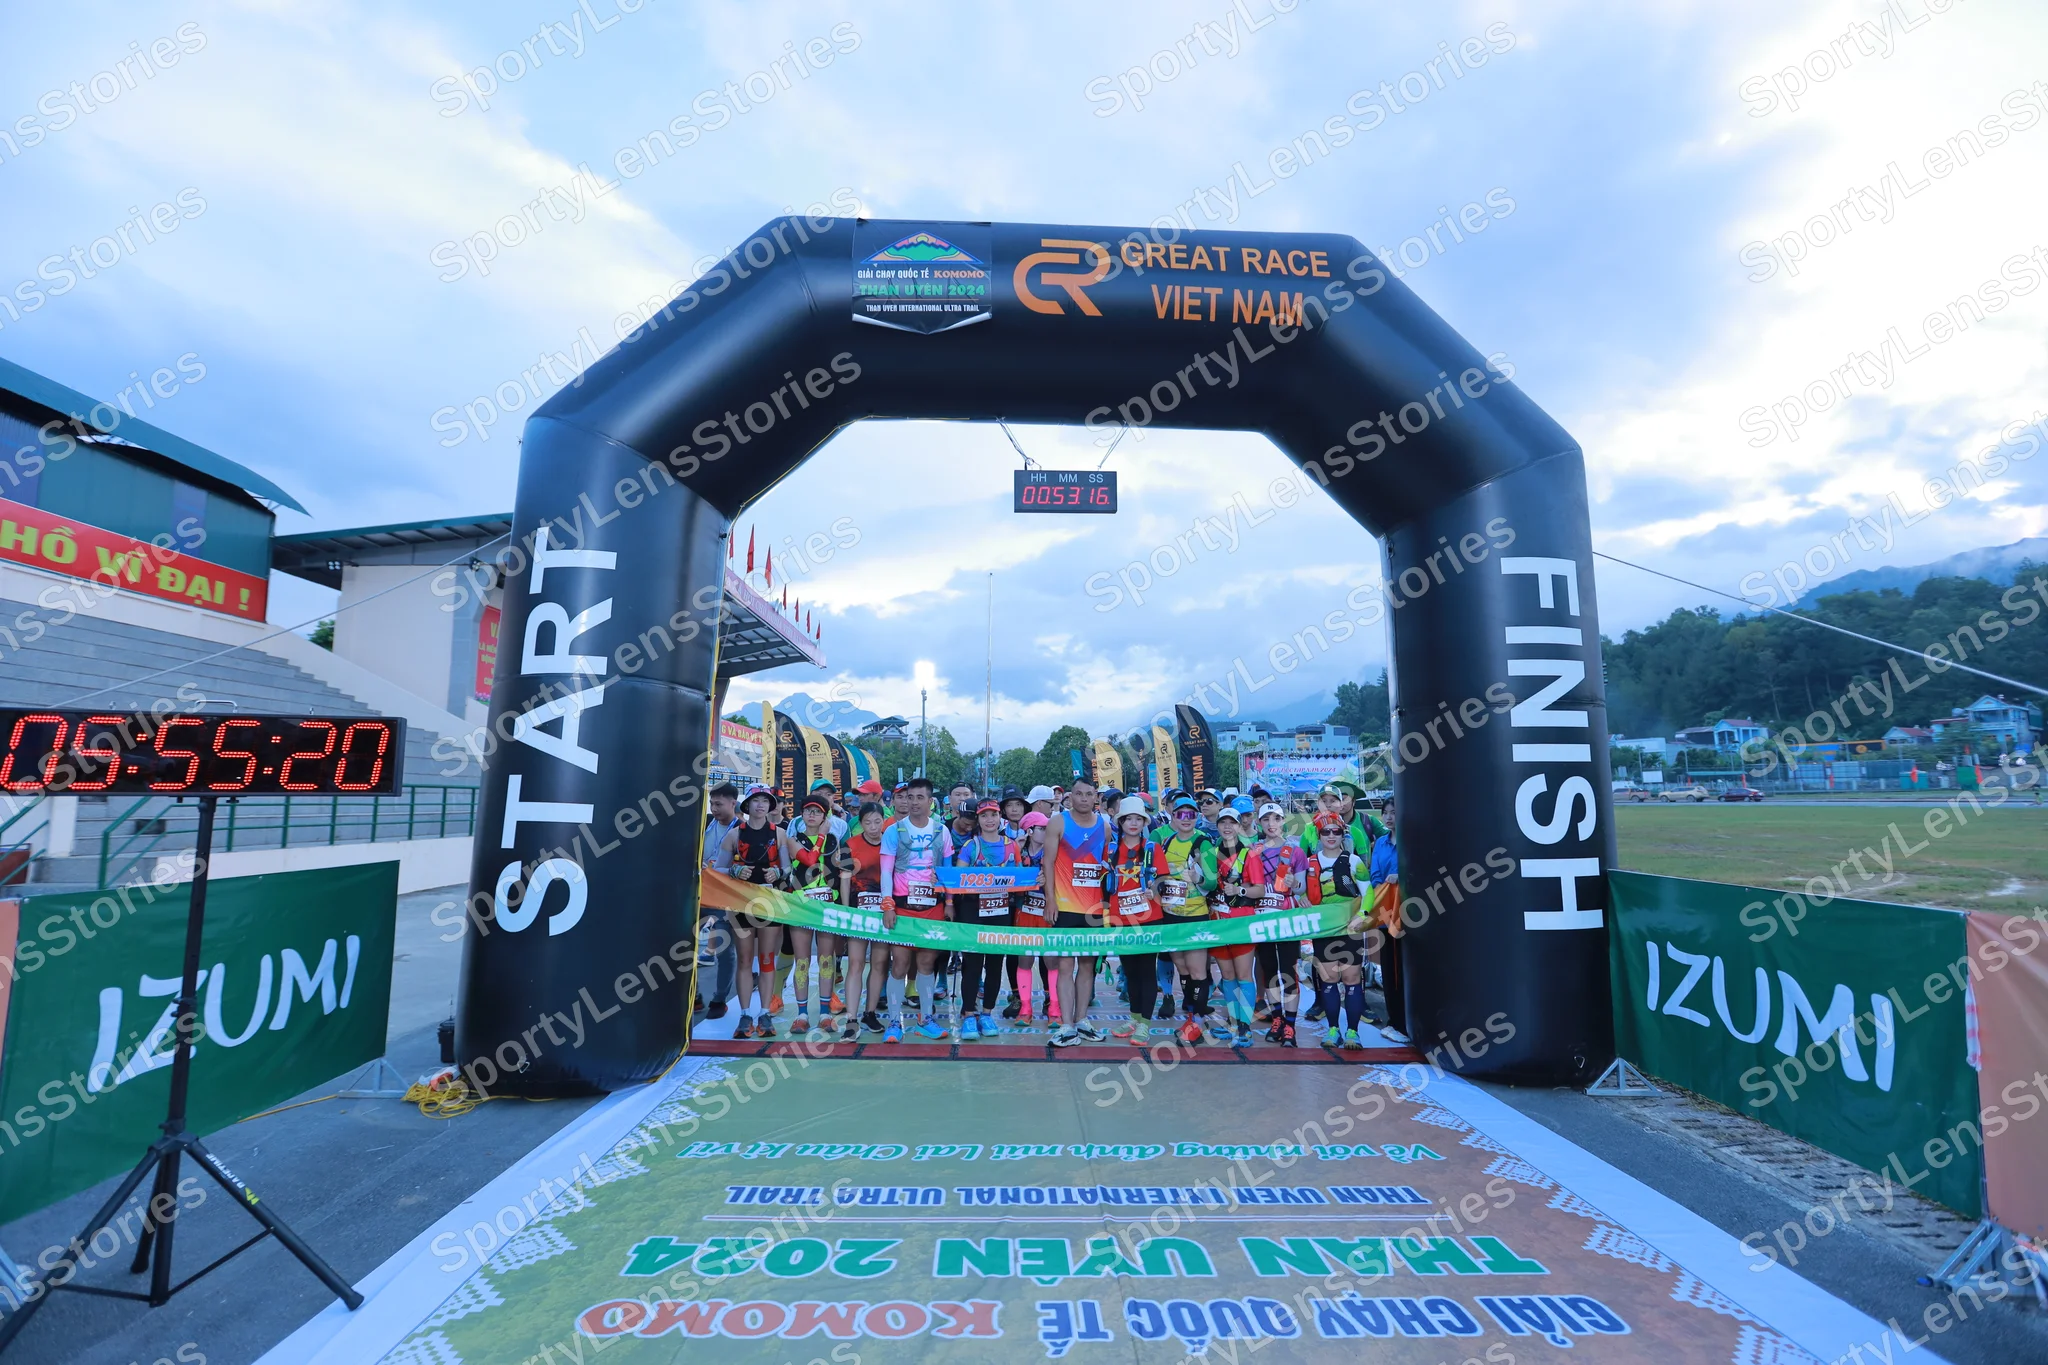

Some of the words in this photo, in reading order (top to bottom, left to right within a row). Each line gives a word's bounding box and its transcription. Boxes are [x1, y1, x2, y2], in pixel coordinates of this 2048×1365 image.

[933, 269, 985, 279] KOMOMO
[1119, 241, 1232, 274] GREAT
[1240, 247, 1332, 278] RACE
[859, 284, 899, 296] THAN
[904, 282, 943, 296] UYÊN
[947, 284, 985, 296] 2024
[1151, 284, 1223, 323] VIET
[1232, 289, 1305, 328] NAM
[899, 304, 942, 312] INTERNATIONAL
[944, 304, 961, 312] ULTRA
[963, 304, 979, 312] TRAIL
[1030, 473, 1047, 483] HH
[1058, 474, 1078, 483] MM
[1088, 473, 1104, 483] SS
[155, 565, 226, 605] ĐẠI
[495, 526, 618, 938] START
[1501, 555, 1604, 930] FINISH
[0, 714, 391, 791] 05:55:20
[782, 757, 794, 800] VIETNAM
[915, 887, 933, 895] 2574
[1079, 869, 1097, 878] 2506
[1165, 886, 1180, 895] 2556
[986, 899, 1004, 907] 2575
[1028, 898, 1046, 907] 2573
[86, 934, 361, 1093] IZUMI
[1645, 940, 1896, 1092] IZUMI
[796, 1140, 909, 1160] Châu
[911, 1142, 983, 1161] Lai
[724, 1185, 824, 1206] TRAIL
[834, 1185, 946, 1206] ULTRA
[955, 1185, 1229, 1206] INTERNATIONAL
[1232, 1185, 1330, 1206] UYEN
[1329, 1185, 1434, 1206] THAN
[620, 1235, 904, 1278] 2024
[932, 1235, 1218, 1287] UYÊN
[1238, 1235, 1550, 1277] THAN
[575, 1298, 1004, 1340] KOMOMO
[1039, 1299, 1113, 1358] TẾ
[1126, 1297, 1303, 1357] QUỐC
[1316, 1290, 1483, 1339] CHẠY
[1480, 1295, 1631, 1348] GIẢI
